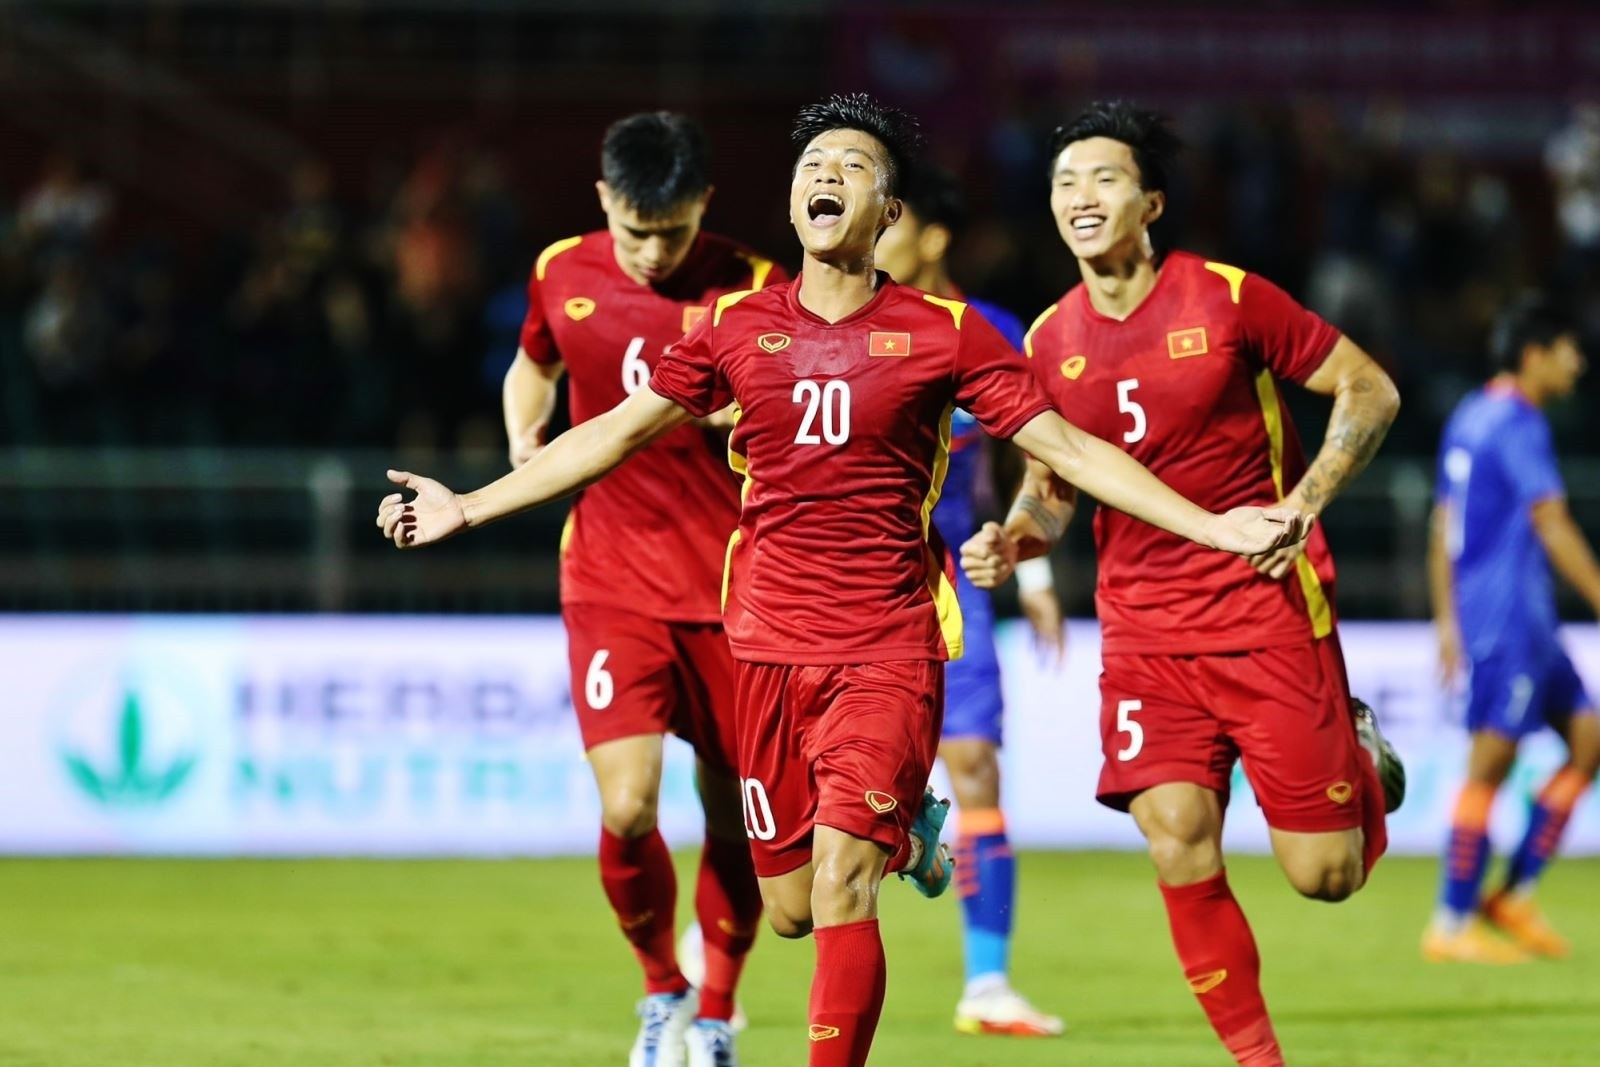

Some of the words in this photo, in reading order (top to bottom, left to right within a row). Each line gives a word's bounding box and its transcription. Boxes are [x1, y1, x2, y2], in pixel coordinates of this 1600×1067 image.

[621, 337, 652, 395] 6
[792, 379, 851, 446] 20
[1116, 378, 1147, 444] 5
[584, 649, 614, 710] 6
[1116, 699, 1144, 763] 5
[740, 776, 777, 842] 0
